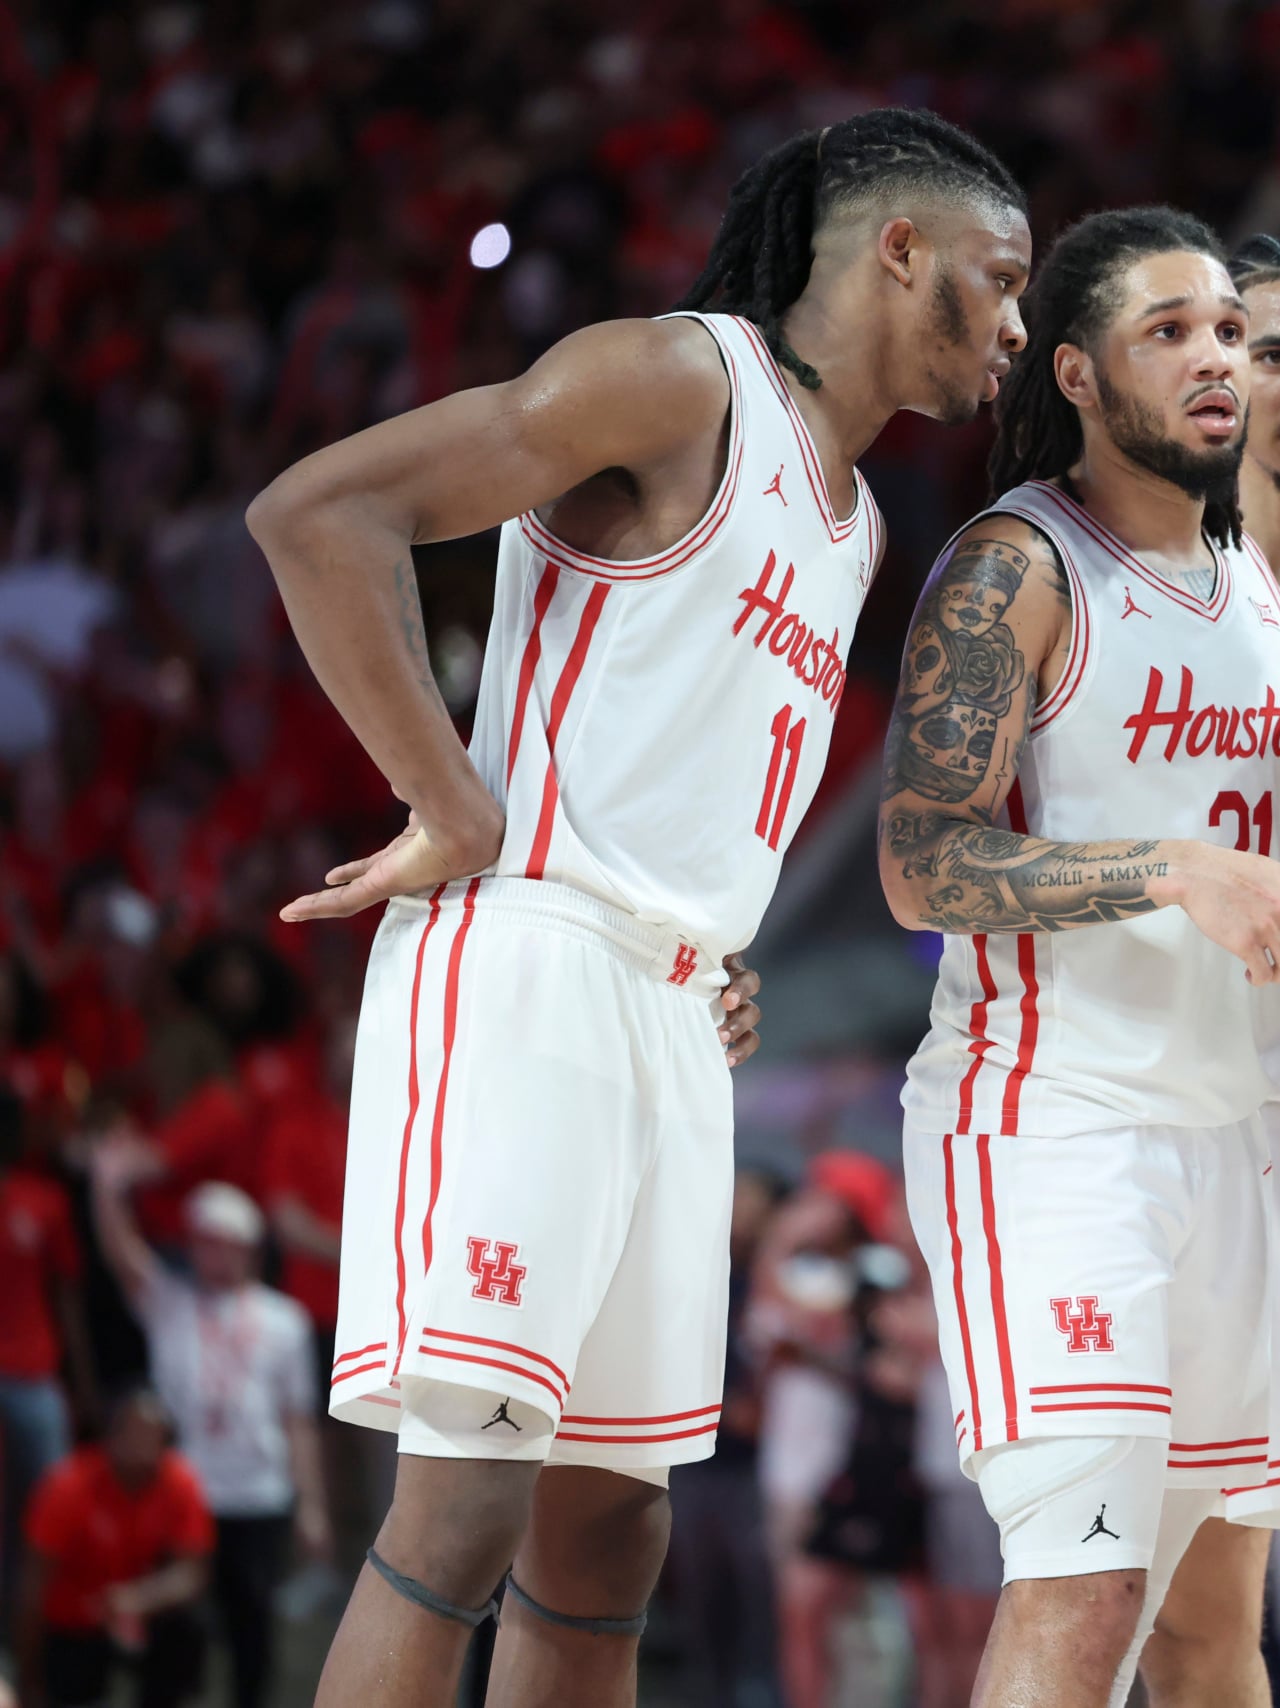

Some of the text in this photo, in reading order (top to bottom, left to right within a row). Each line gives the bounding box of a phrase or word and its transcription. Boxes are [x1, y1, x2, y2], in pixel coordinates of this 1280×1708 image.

[755, 703, 806, 852] 11
[1022, 870, 1083, 887] MCMLII
[1100, 862, 1169, 883] MMXVII
[467, 1236, 526, 1306] UH
[1050, 1296, 1114, 1353] UH
